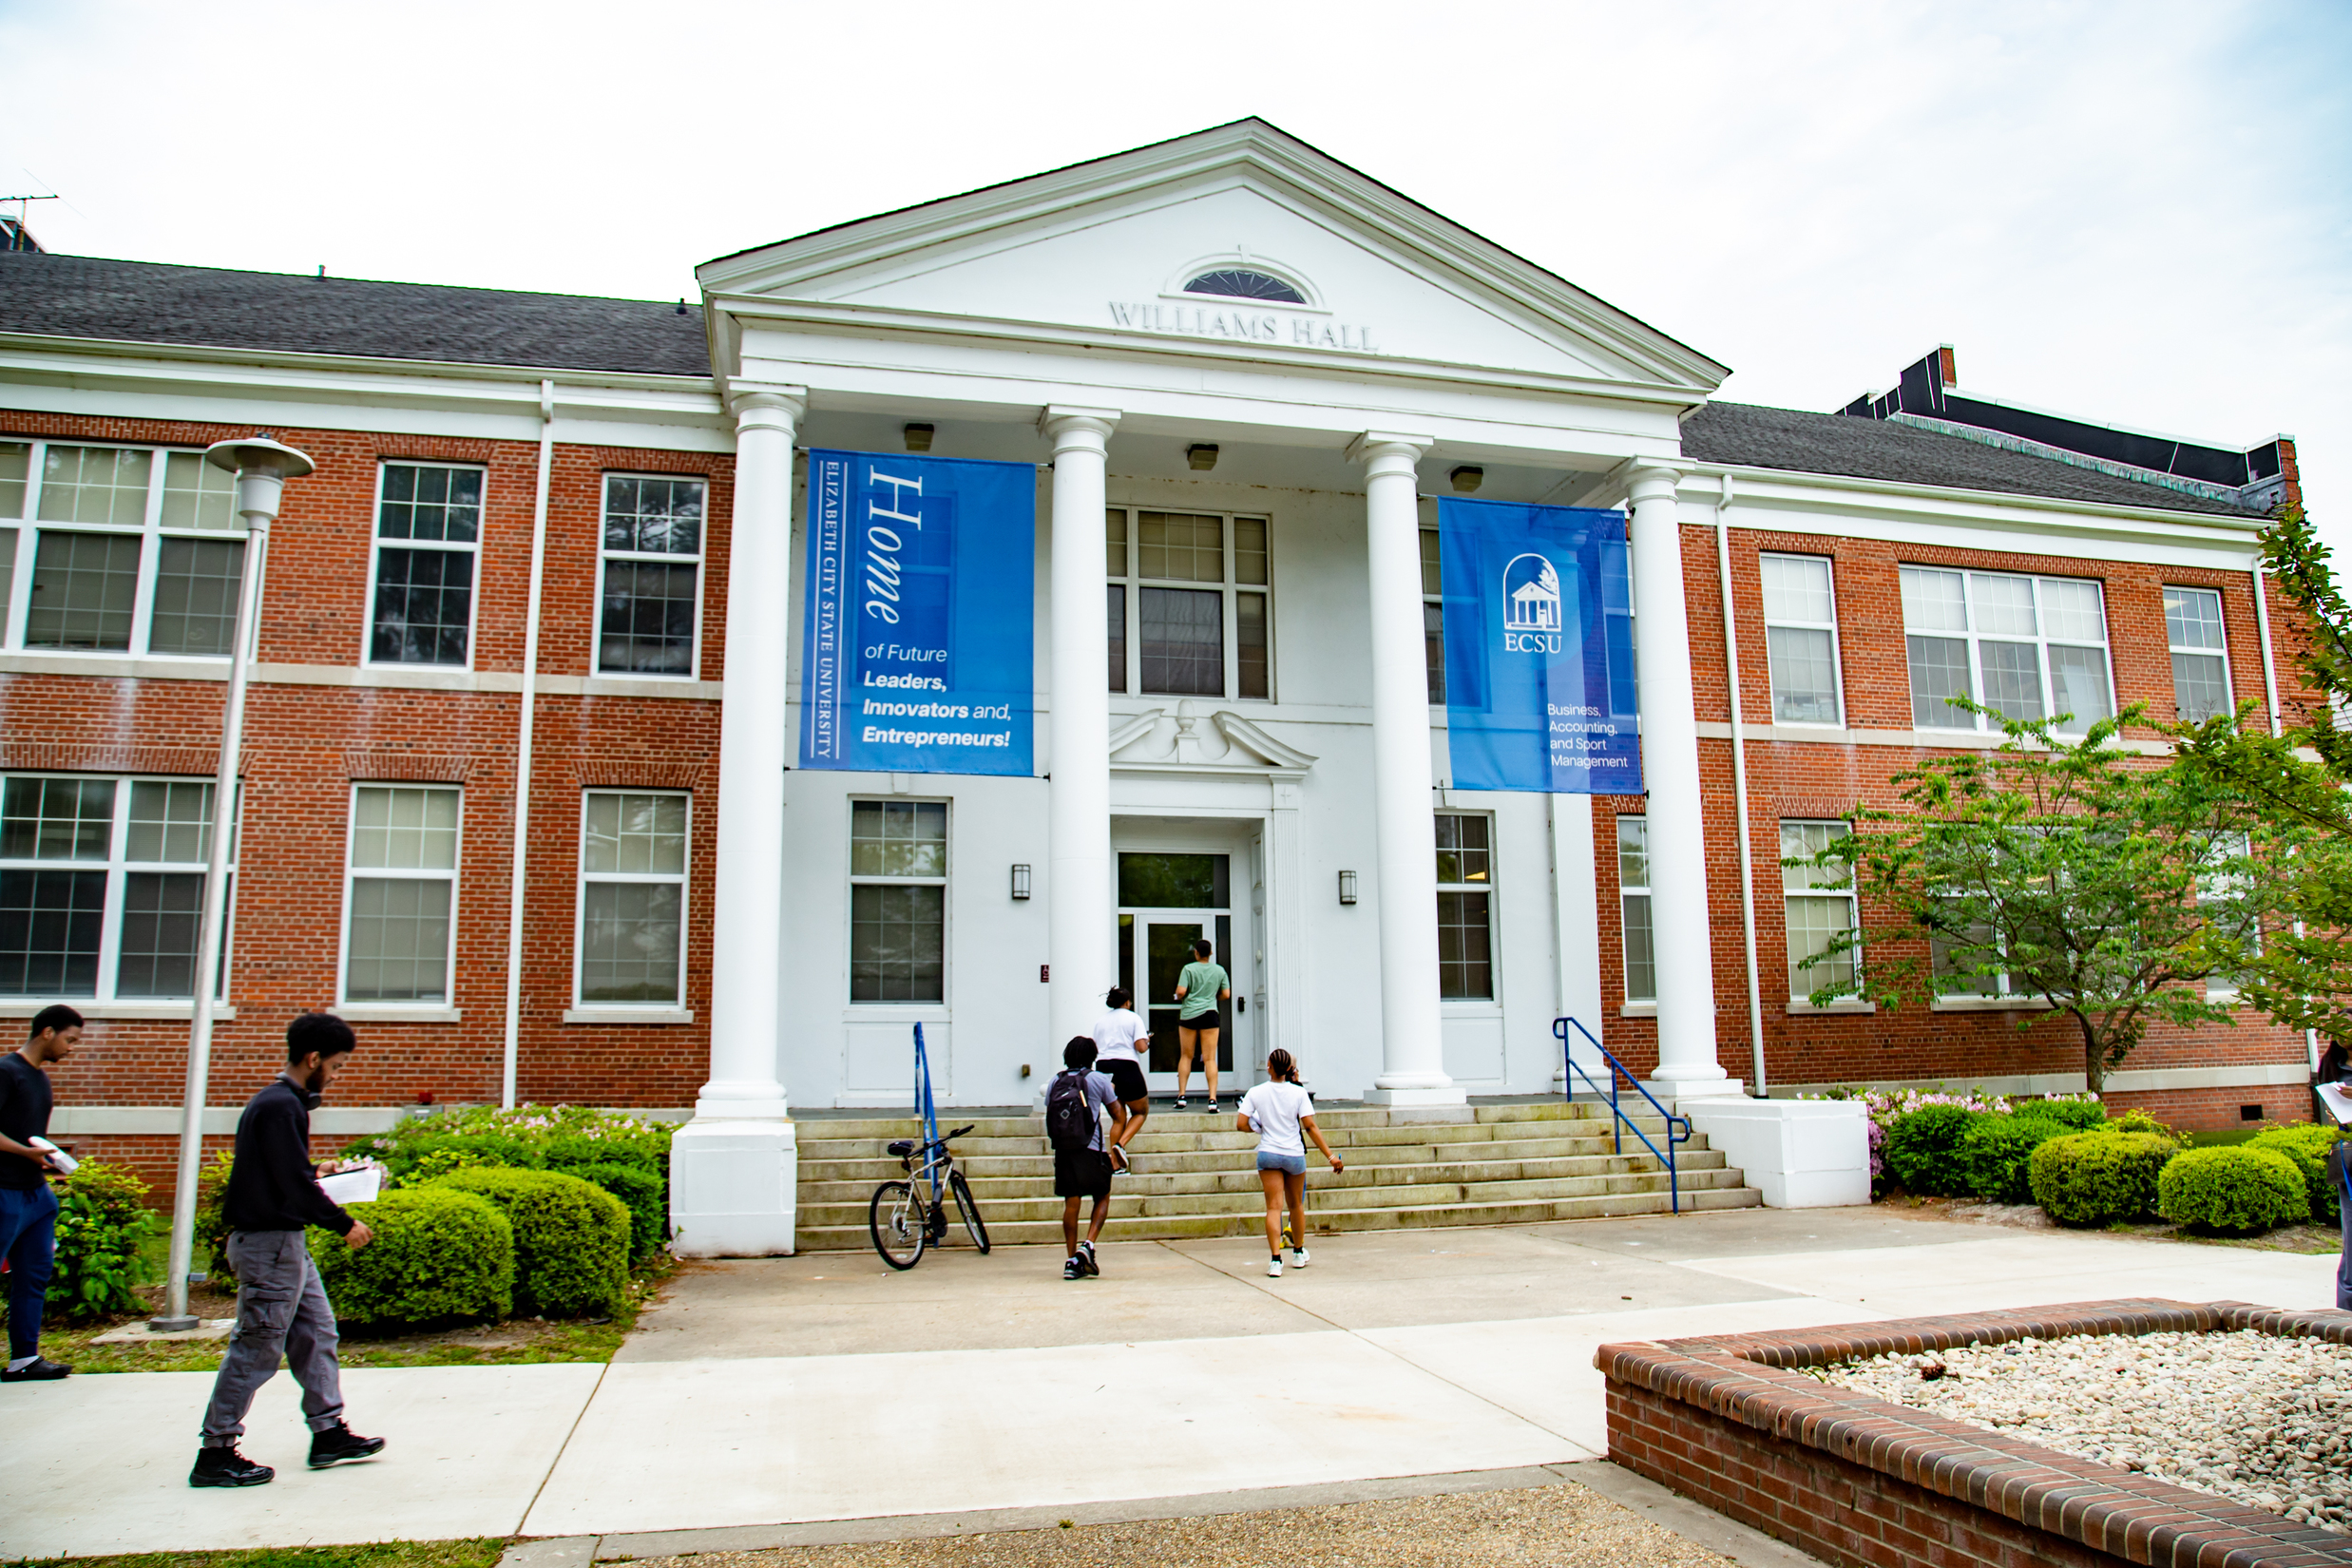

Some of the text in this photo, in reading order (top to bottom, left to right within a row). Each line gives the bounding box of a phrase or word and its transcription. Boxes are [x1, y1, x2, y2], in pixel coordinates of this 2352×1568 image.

[1109, 301, 1379, 351] WILLIAMS HALL
[866, 465, 923, 624] Home
[817, 461, 839, 758] ELIZABETH CITY STATE UNIVERSITY
[865, 643, 947, 662] of Future
[1504, 633, 1562, 654] ECSU
[864, 670, 947, 693] Leaders,
[863, 698, 969, 718] Innovators
[1547, 703, 1601, 717] Business,
[862, 726, 1011, 748] Entrepreneurs!
[1549, 720, 1618, 736] Accounting,
[1550, 737, 1607, 752] and Sport
[1551, 754, 1628, 770] Management
